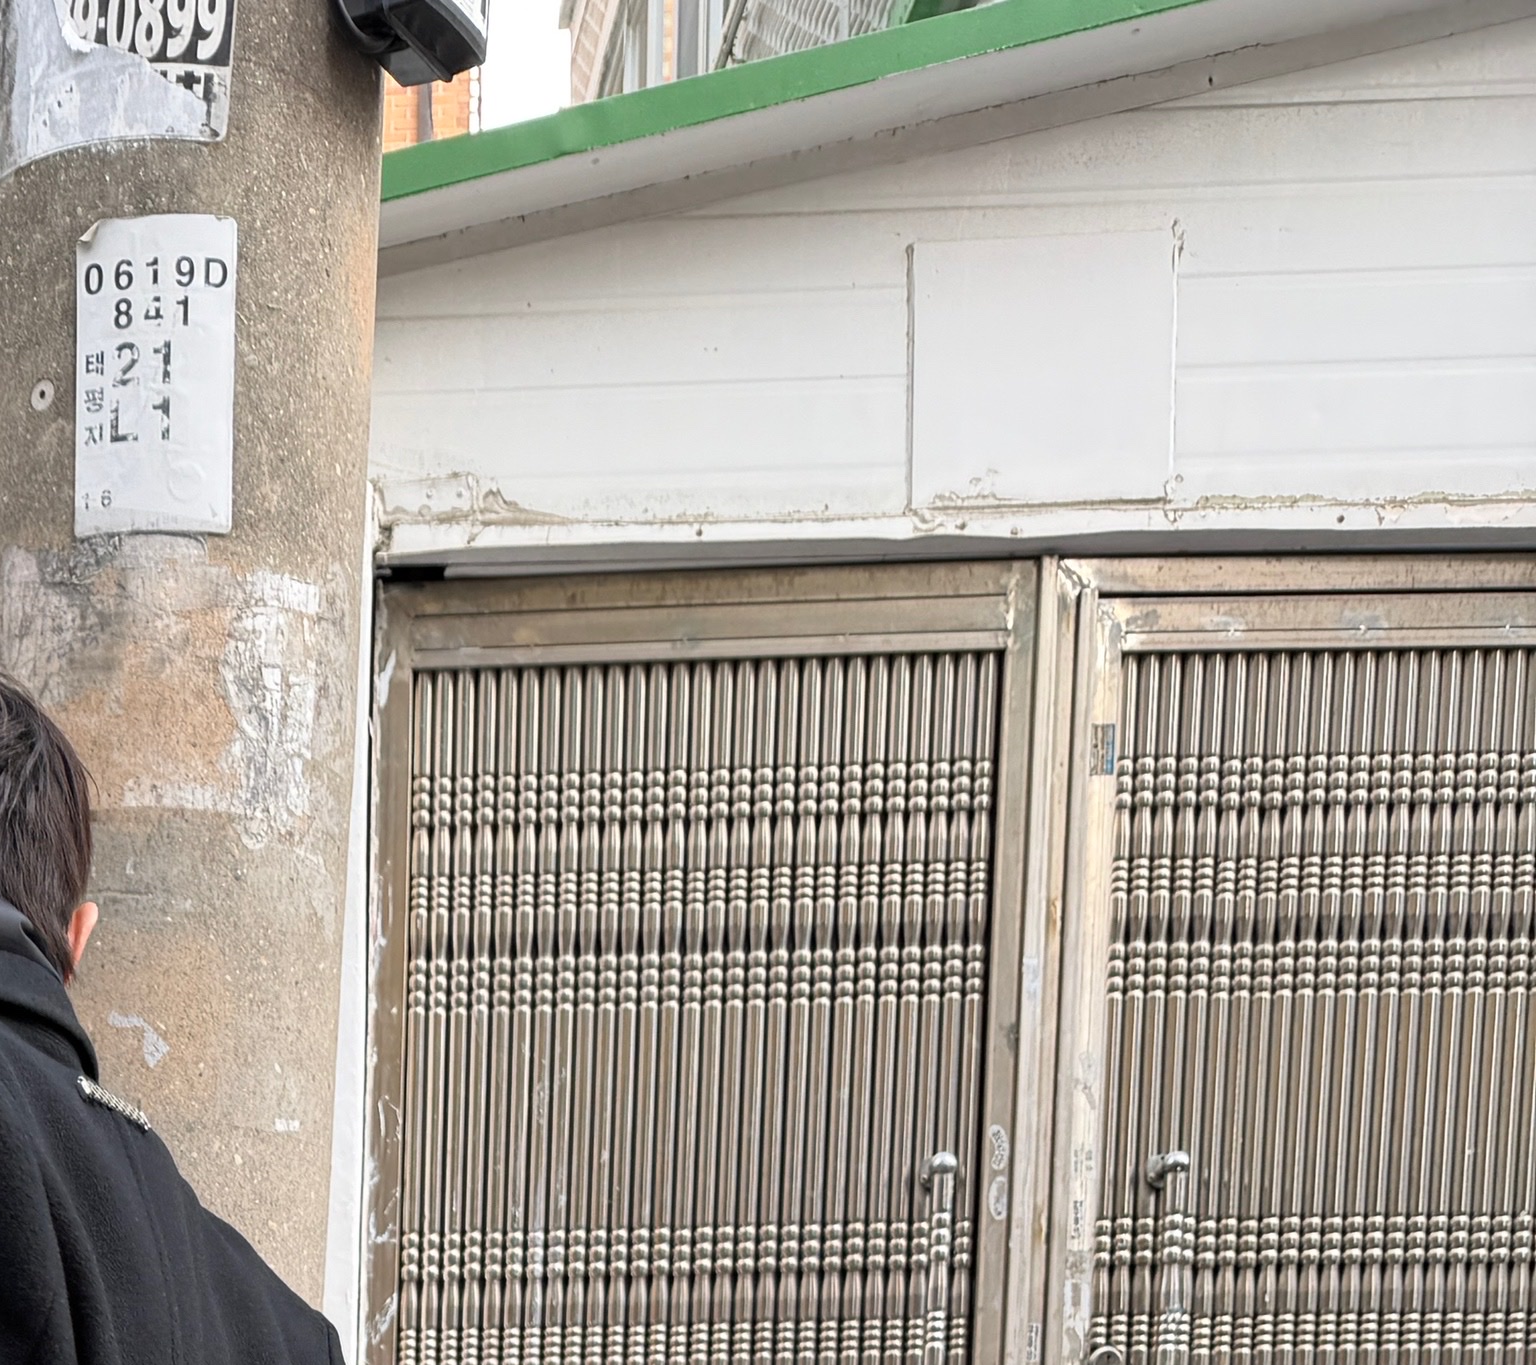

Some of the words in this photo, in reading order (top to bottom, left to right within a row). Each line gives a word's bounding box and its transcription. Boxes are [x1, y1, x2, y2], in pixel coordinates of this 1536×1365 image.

[84, 255, 228, 295] 0619D
[113, 295, 190, 330] 841
[112, 339, 172, 388] 21
